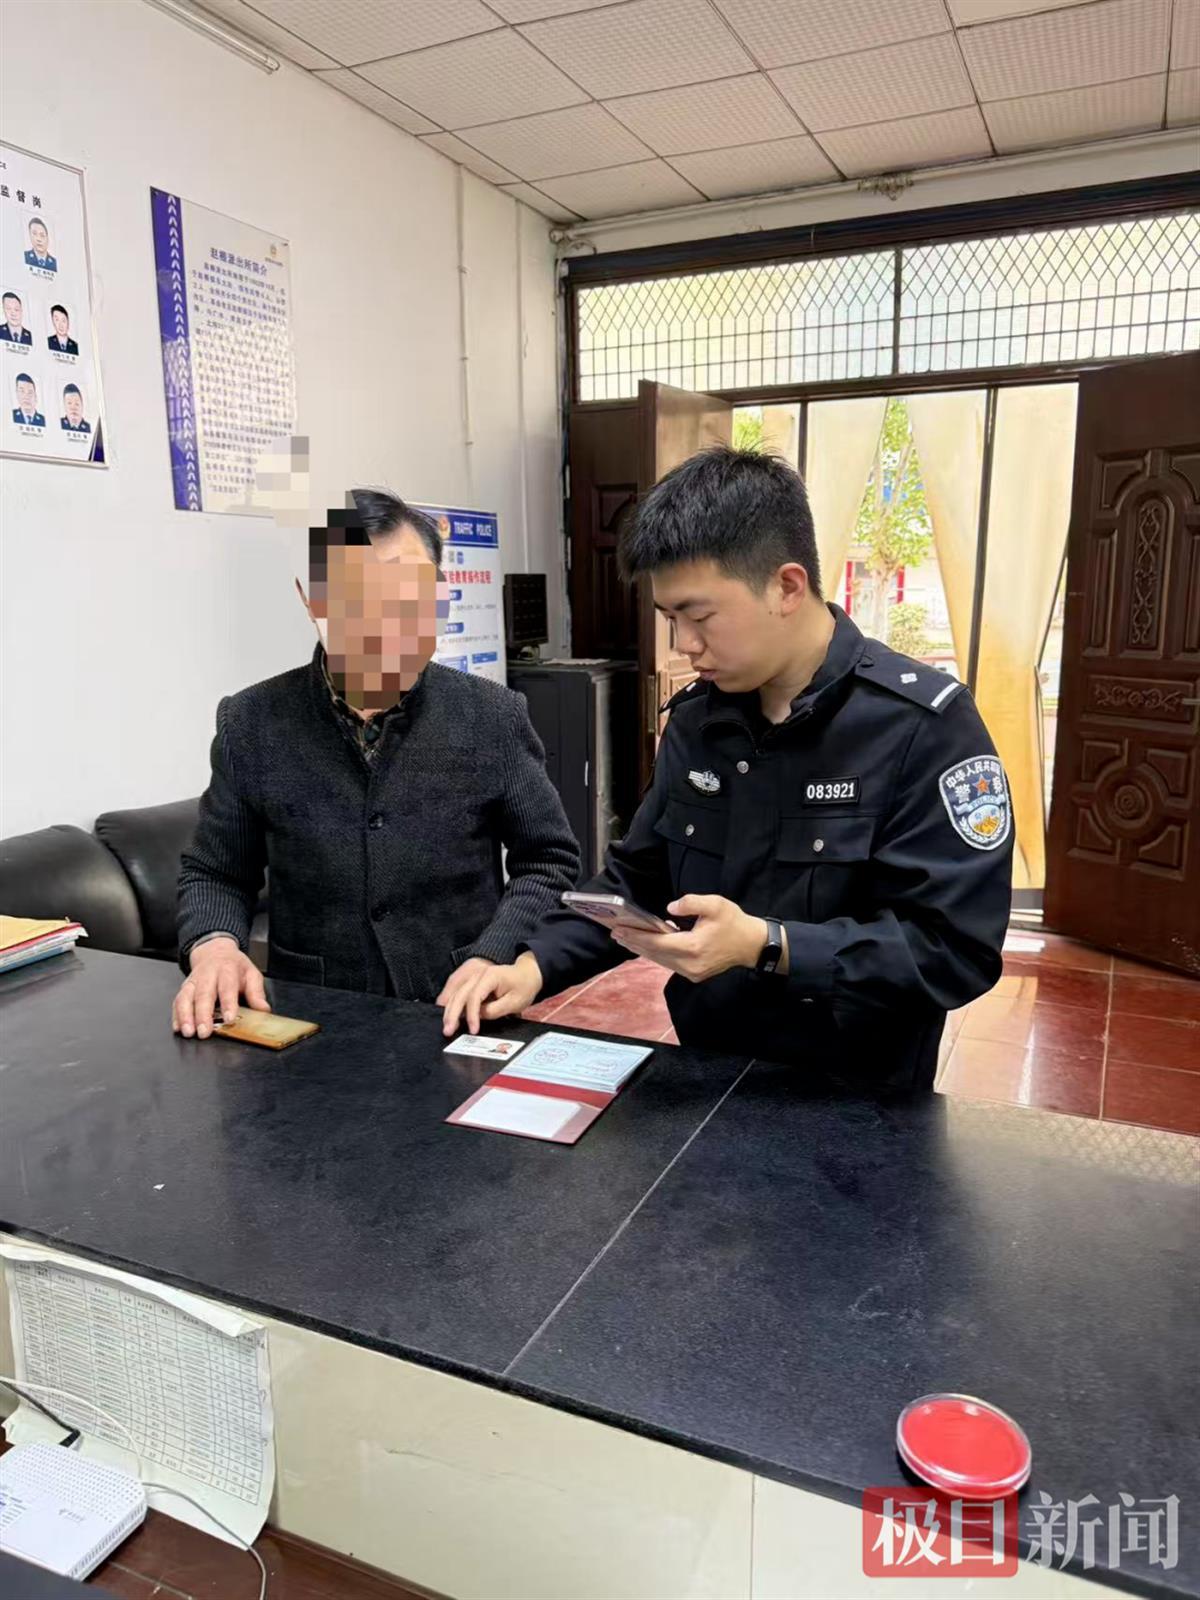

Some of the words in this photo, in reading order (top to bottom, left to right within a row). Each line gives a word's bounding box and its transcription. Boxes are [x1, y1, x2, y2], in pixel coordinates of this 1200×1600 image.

[453, 521, 474, 535] TRAFFIC
[476, 523, 493, 537] POLICE
[807, 782, 855, 799] 083921
